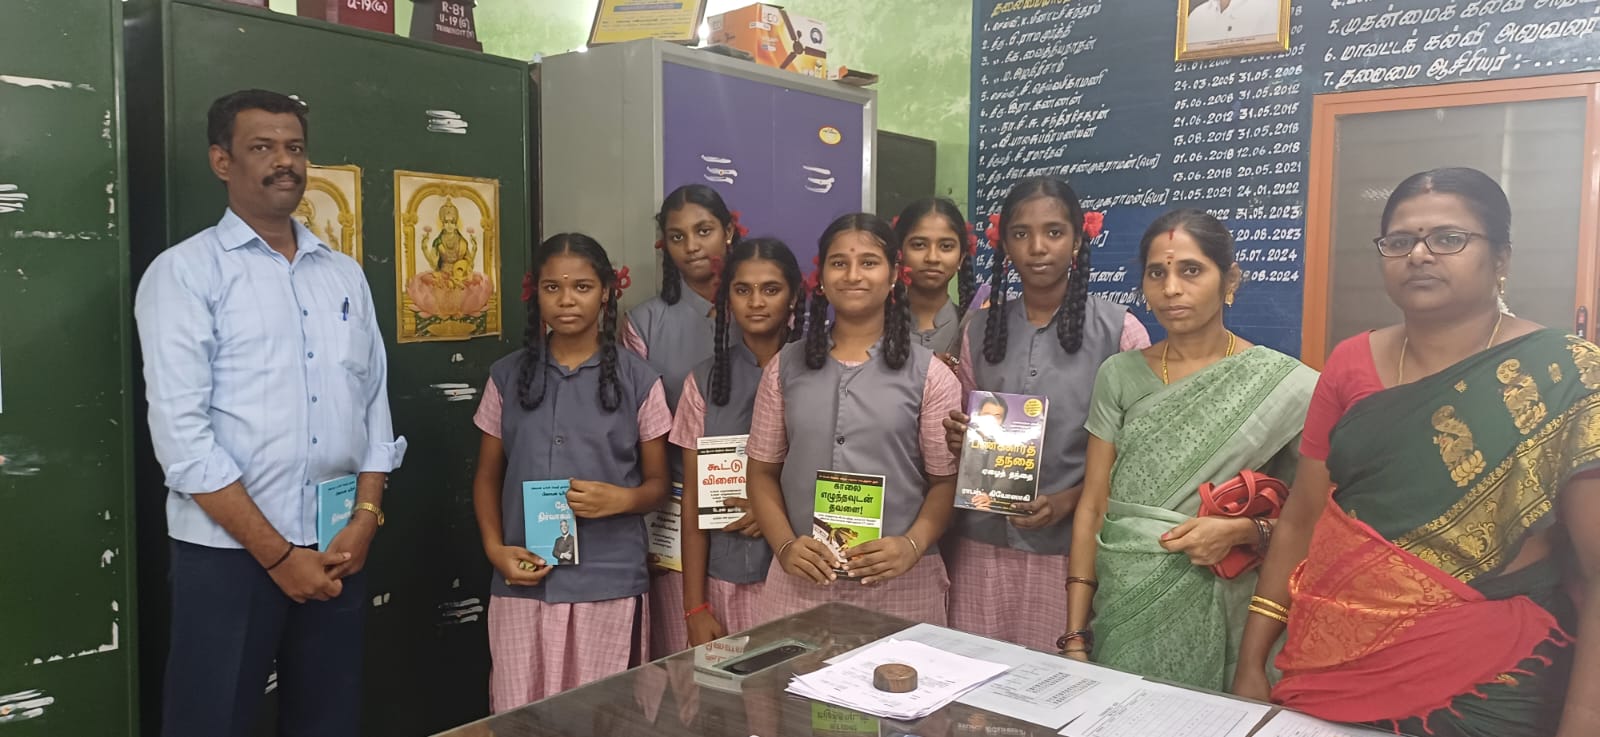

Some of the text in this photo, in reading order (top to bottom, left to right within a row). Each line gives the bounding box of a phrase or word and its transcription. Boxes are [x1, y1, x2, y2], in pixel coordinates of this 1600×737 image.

[442, 1, 464, 17] R-81
[1423, 21, 1491, 51] கல்வி
[1237, 161, 1302, 178] 20.05.2021
[1172, 186, 1232, 201] 21.05.2021
[1237, 181, 1300, 198] 24.01.2022
[1235, 248, 1298, 262] 15.07.2024
[707, 459, 743, 473] கூட்டு
[995, 453, 1035, 470] தந்தை
[834, 483, 862, 492] காலை
[820, 491, 874, 504] எழுந்தவுடன்
[828, 504, 863, 515] தவளை!
